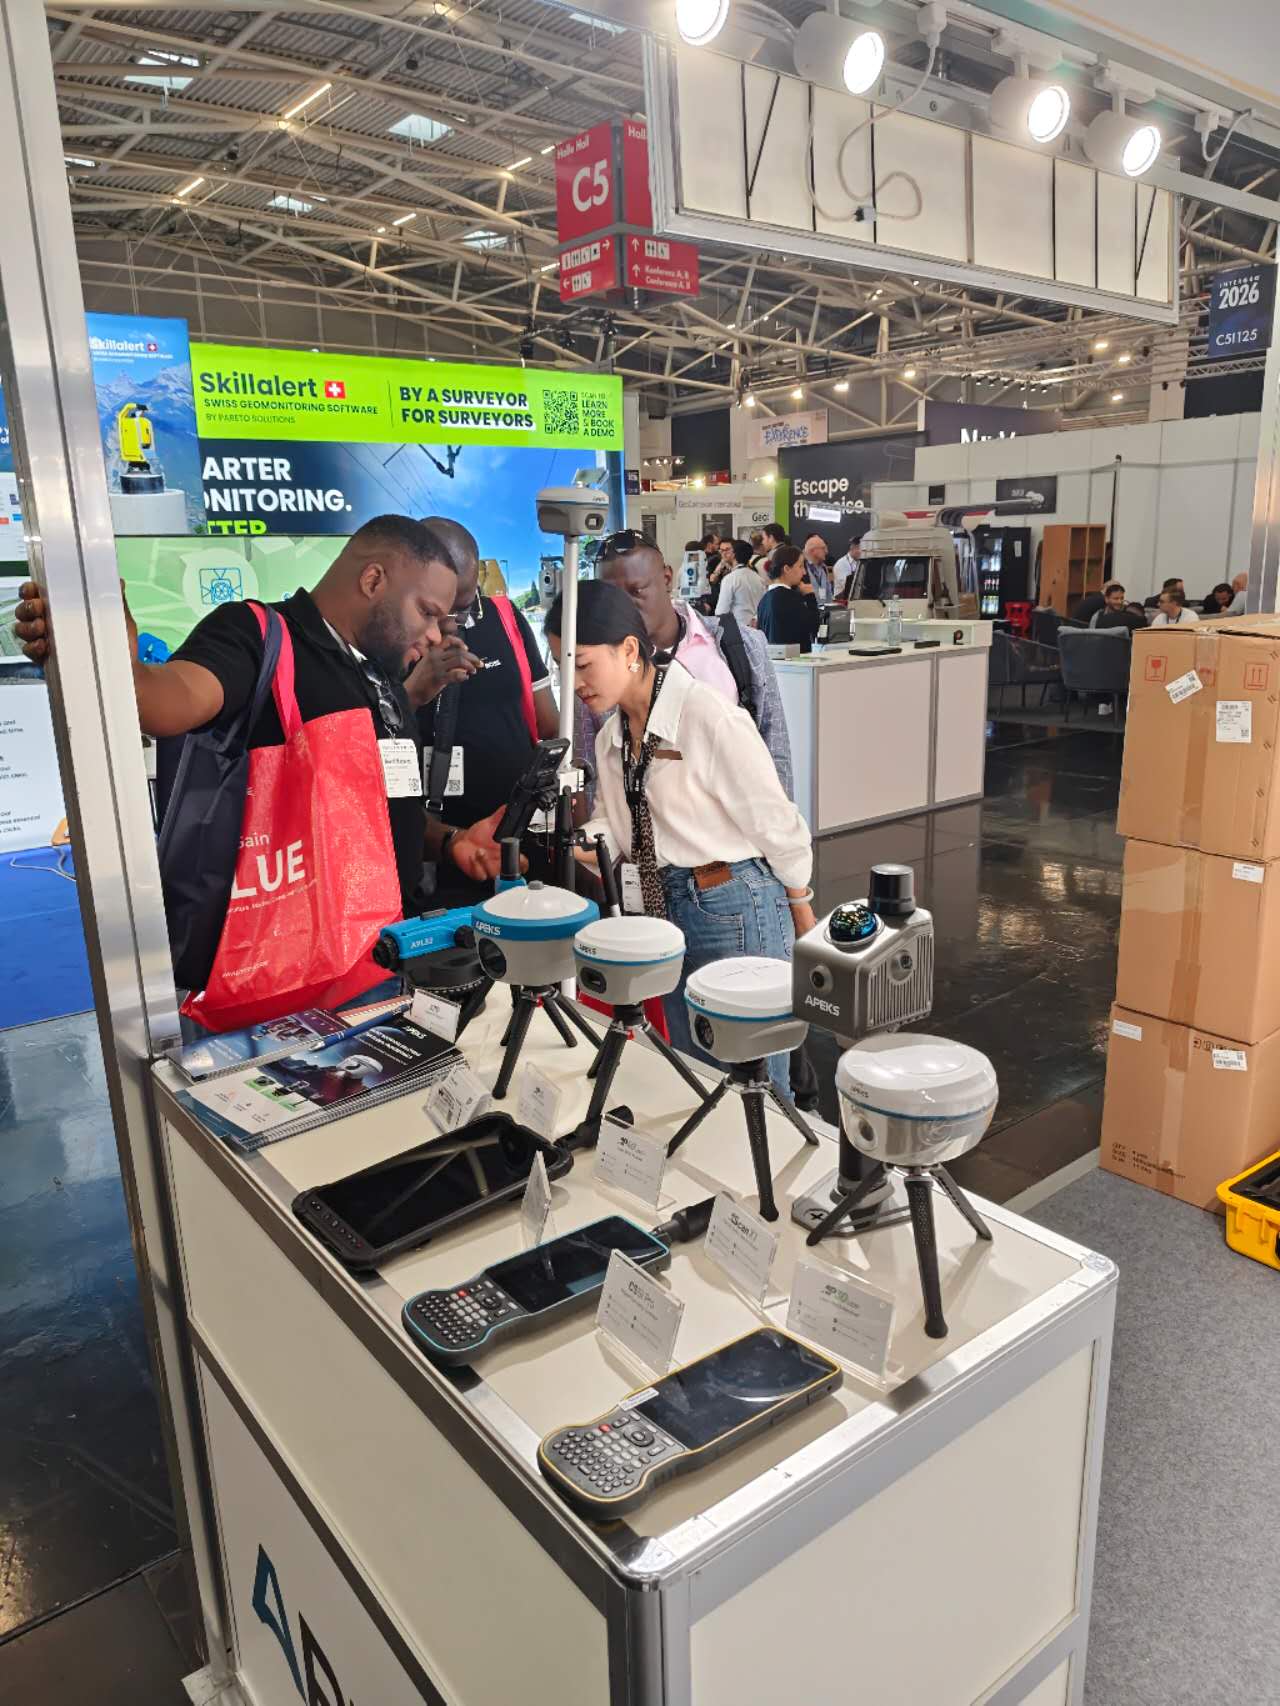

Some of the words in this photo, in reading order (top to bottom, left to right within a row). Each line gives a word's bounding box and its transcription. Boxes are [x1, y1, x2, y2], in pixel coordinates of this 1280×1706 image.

[572, 159, 609, 212] C5
[1218, 282, 1260, 310] 2026
[200, 371, 317, 398] Skillalert
[204, 399, 237, 408] SWISS
[240, 400, 325, 412] GEOMONITORING
[327, 404, 378, 415] SOFTWARE
[400, 386, 423, 402] BY
[427, 388, 439, 403] A
[442, 389, 527, 407] SURVEYOR
[582, 400, 608, 410] LEARN
[206, 413, 216, 421] BY
[219, 413, 250, 423] PARETO
[252, 414, 296, 424] SOLUTIONS
[402, 408, 435, 424] FOR
[439, 410, 534, 427] SURVEYORS
[583, 409, 606, 418] MORE
[591, 418, 615, 428] BOOK
[583, 428, 590, 437] A
[591, 428, 615, 437] DEMO
[202, 456, 292, 481] ARTER
[793, 477, 849, 499] Escape
[231, 839, 306, 900] LUE
[804, 993, 841, 1017] APEKS
